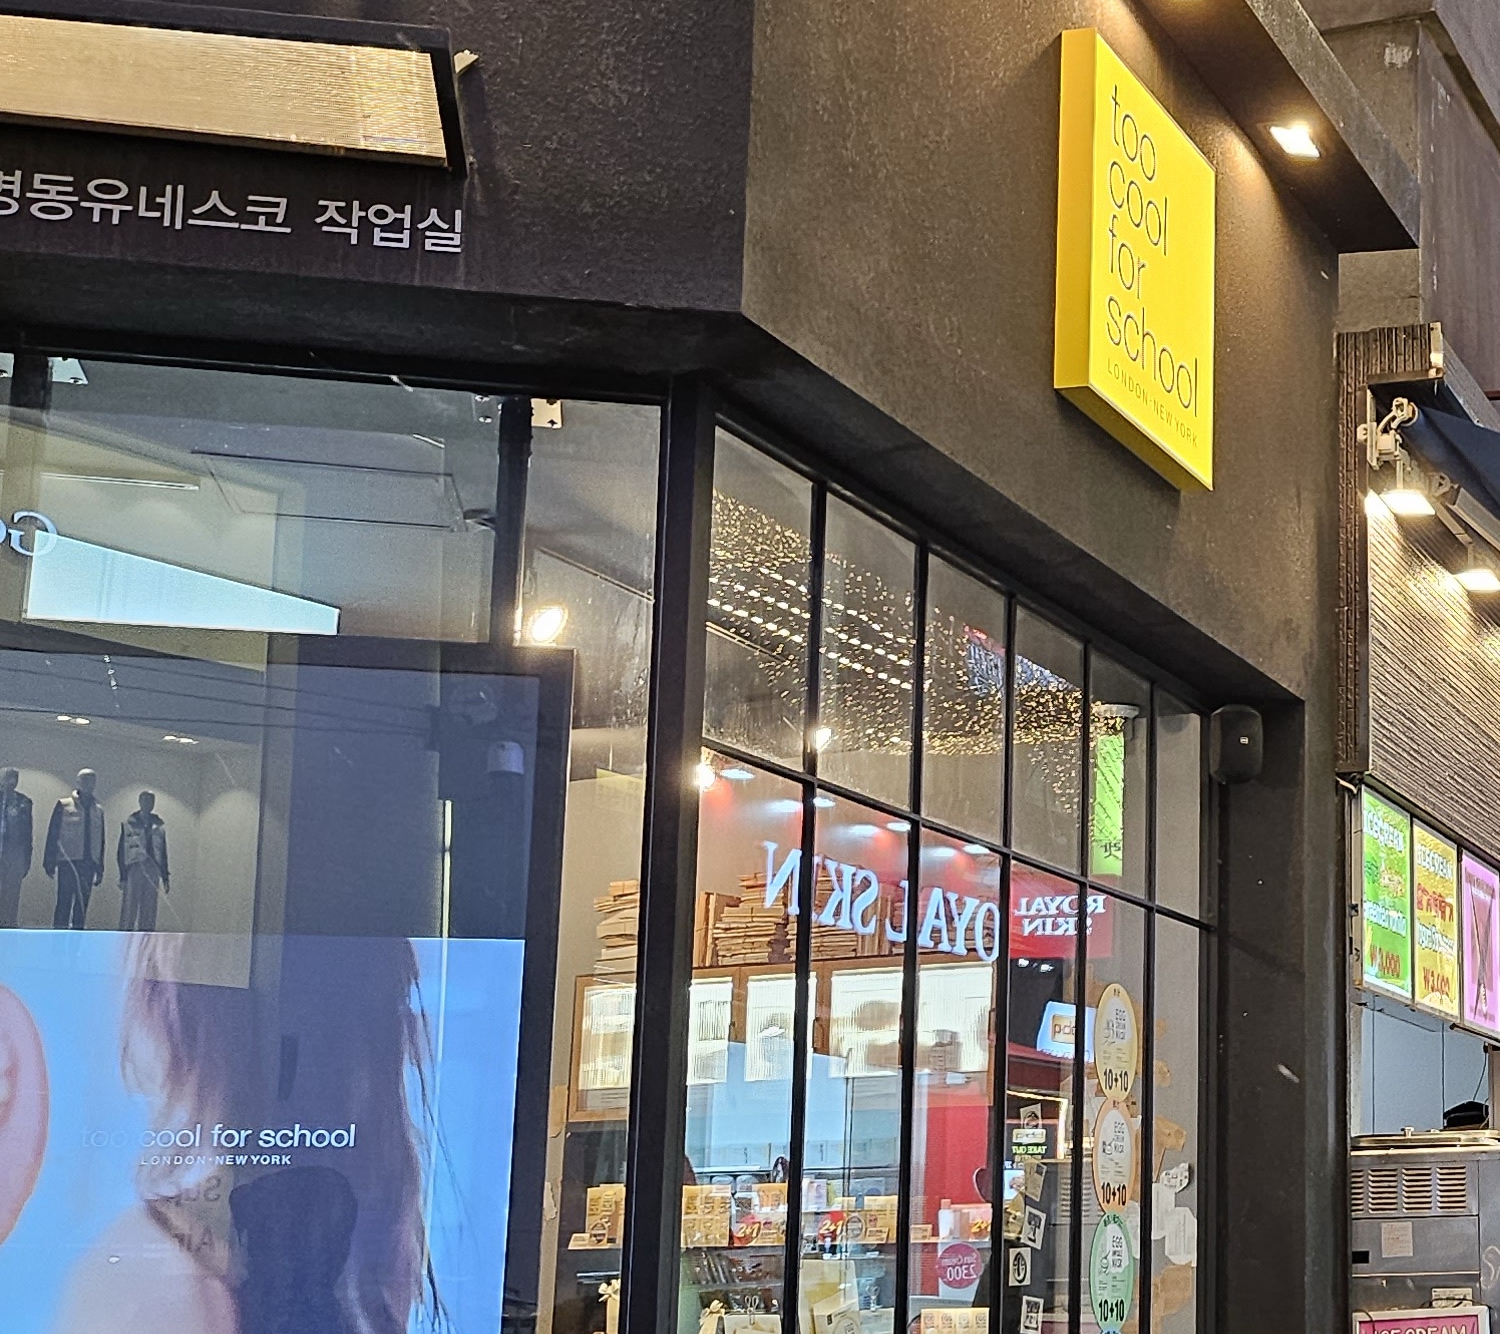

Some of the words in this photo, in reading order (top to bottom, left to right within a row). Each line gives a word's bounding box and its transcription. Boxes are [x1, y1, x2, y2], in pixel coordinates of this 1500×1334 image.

[1111, 84, 1156, 181] too
[1109, 161, 1168, 256] cool
[314, 197, 462, 254] 작업실
[1109, 214, 1146, 300] for
[1106, 296, 1198, 417] school
[1103, 1068, 1129, 1092] 10+10
[138, 1124, 201, 1148] cool
[211, 1123, 252, 1148] for
[258, 1123, 356, 1148] school
[251, 1154, 292, 1166] YORK
[1101, 1181, 1127, 1206] 10+10
[736, 1222, 760, 1238] 2+1
[821, 1219, 844, 1234] 2+1
[1099, 1299, 1125, 1322] 10+10
